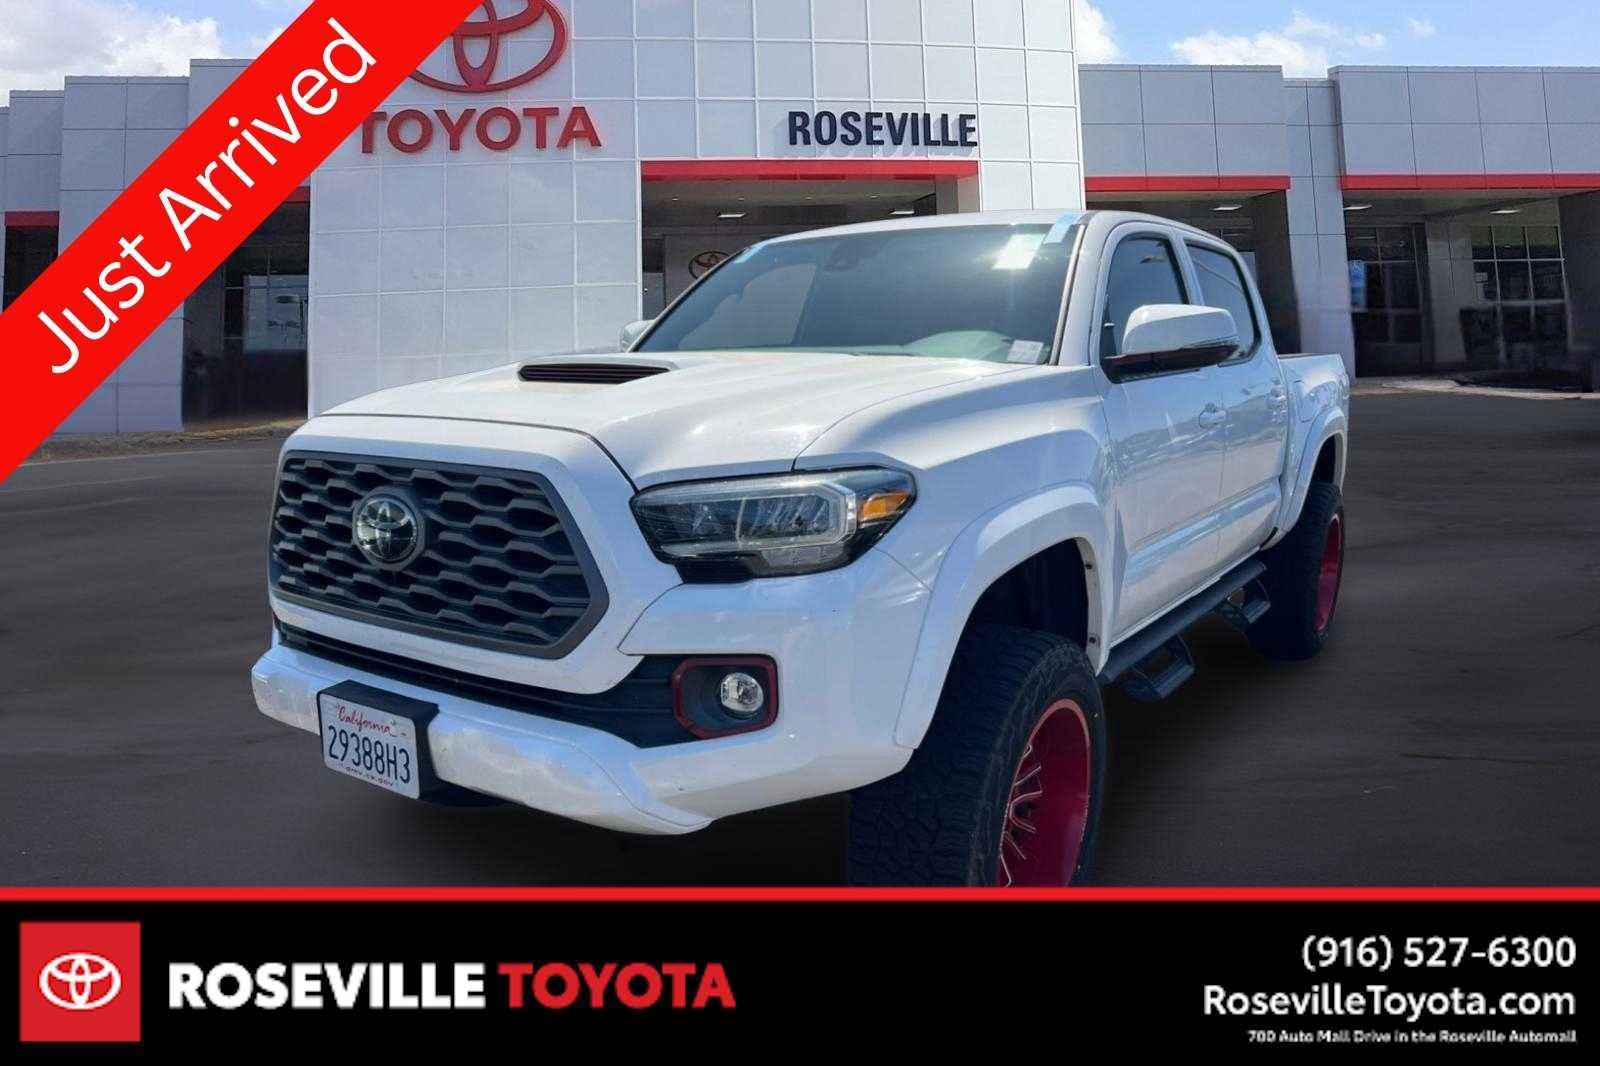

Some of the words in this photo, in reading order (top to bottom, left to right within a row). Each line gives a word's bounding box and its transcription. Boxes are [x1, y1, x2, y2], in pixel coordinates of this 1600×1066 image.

[361, 106, 602, 154] TOYOTA
[788, 110, 979, 148] ROSEVILLE
[328, 724, 411, 784] 29388H3
